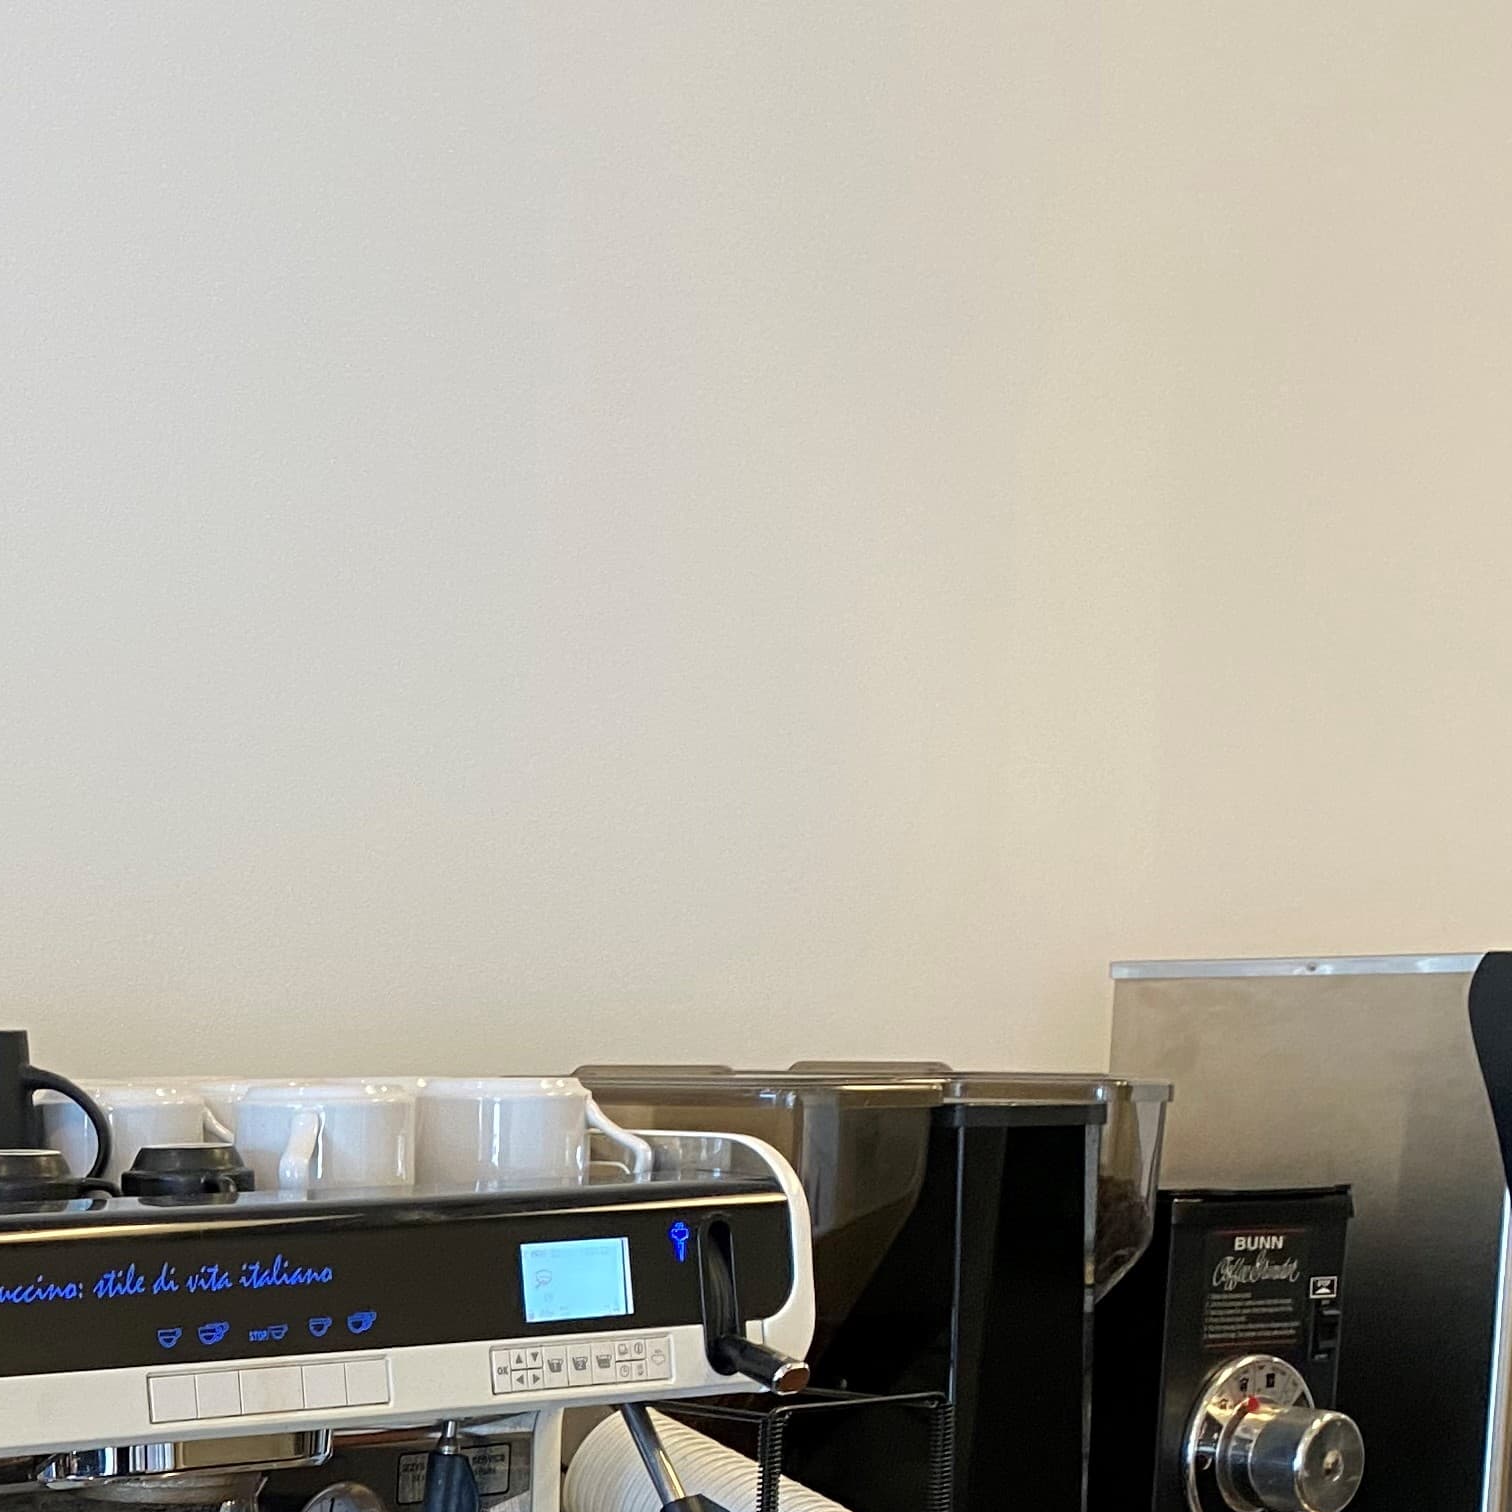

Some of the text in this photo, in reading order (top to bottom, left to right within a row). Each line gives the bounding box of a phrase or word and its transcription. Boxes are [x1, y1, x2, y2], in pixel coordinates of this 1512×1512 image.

[1234, 1235, 1285, 1251] BUNN
[92, 1263, 145, 1299] stile
[152, 1261, 179, 1295] di
[186, 1264, 233, 1293] vita
[238, 1253, 333, 1289] italiano
[497, 1366, 508, 1375] OK
